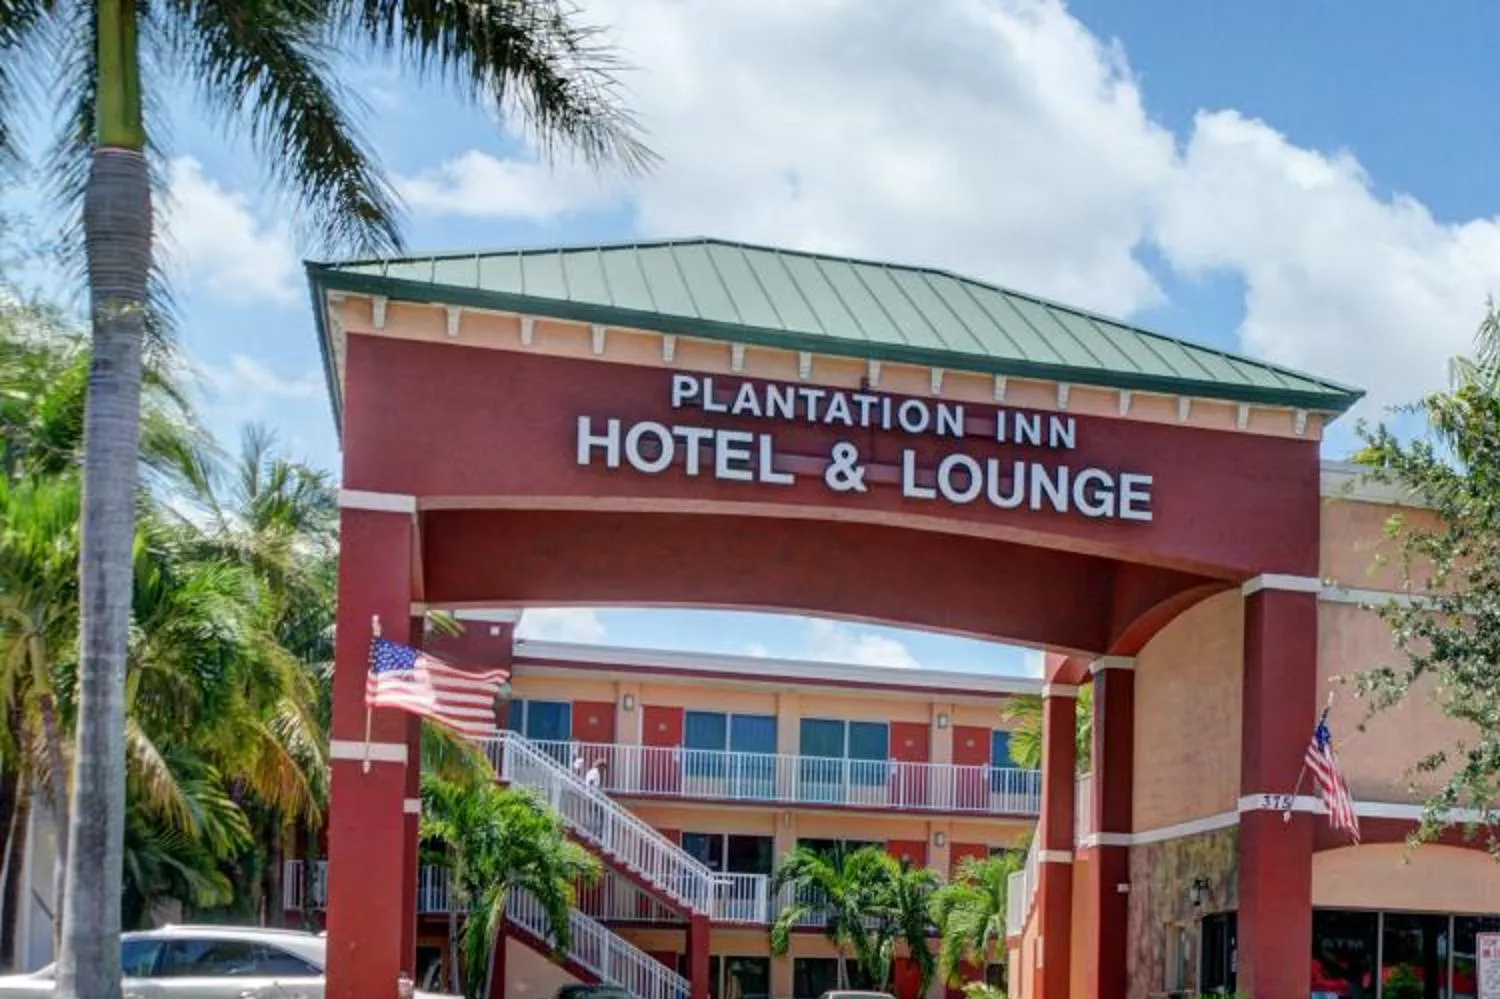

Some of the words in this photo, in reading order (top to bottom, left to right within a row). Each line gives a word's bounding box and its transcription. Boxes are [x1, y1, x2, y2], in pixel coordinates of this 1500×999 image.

[672, 374, 965, 437] PLANTATION
[997, 411, 1076, 449] INN
[577, 416, 795, 485] HOTEL
[825, 442, 867, 493] &
[903, 449, 1153, 521] LOUNGE
